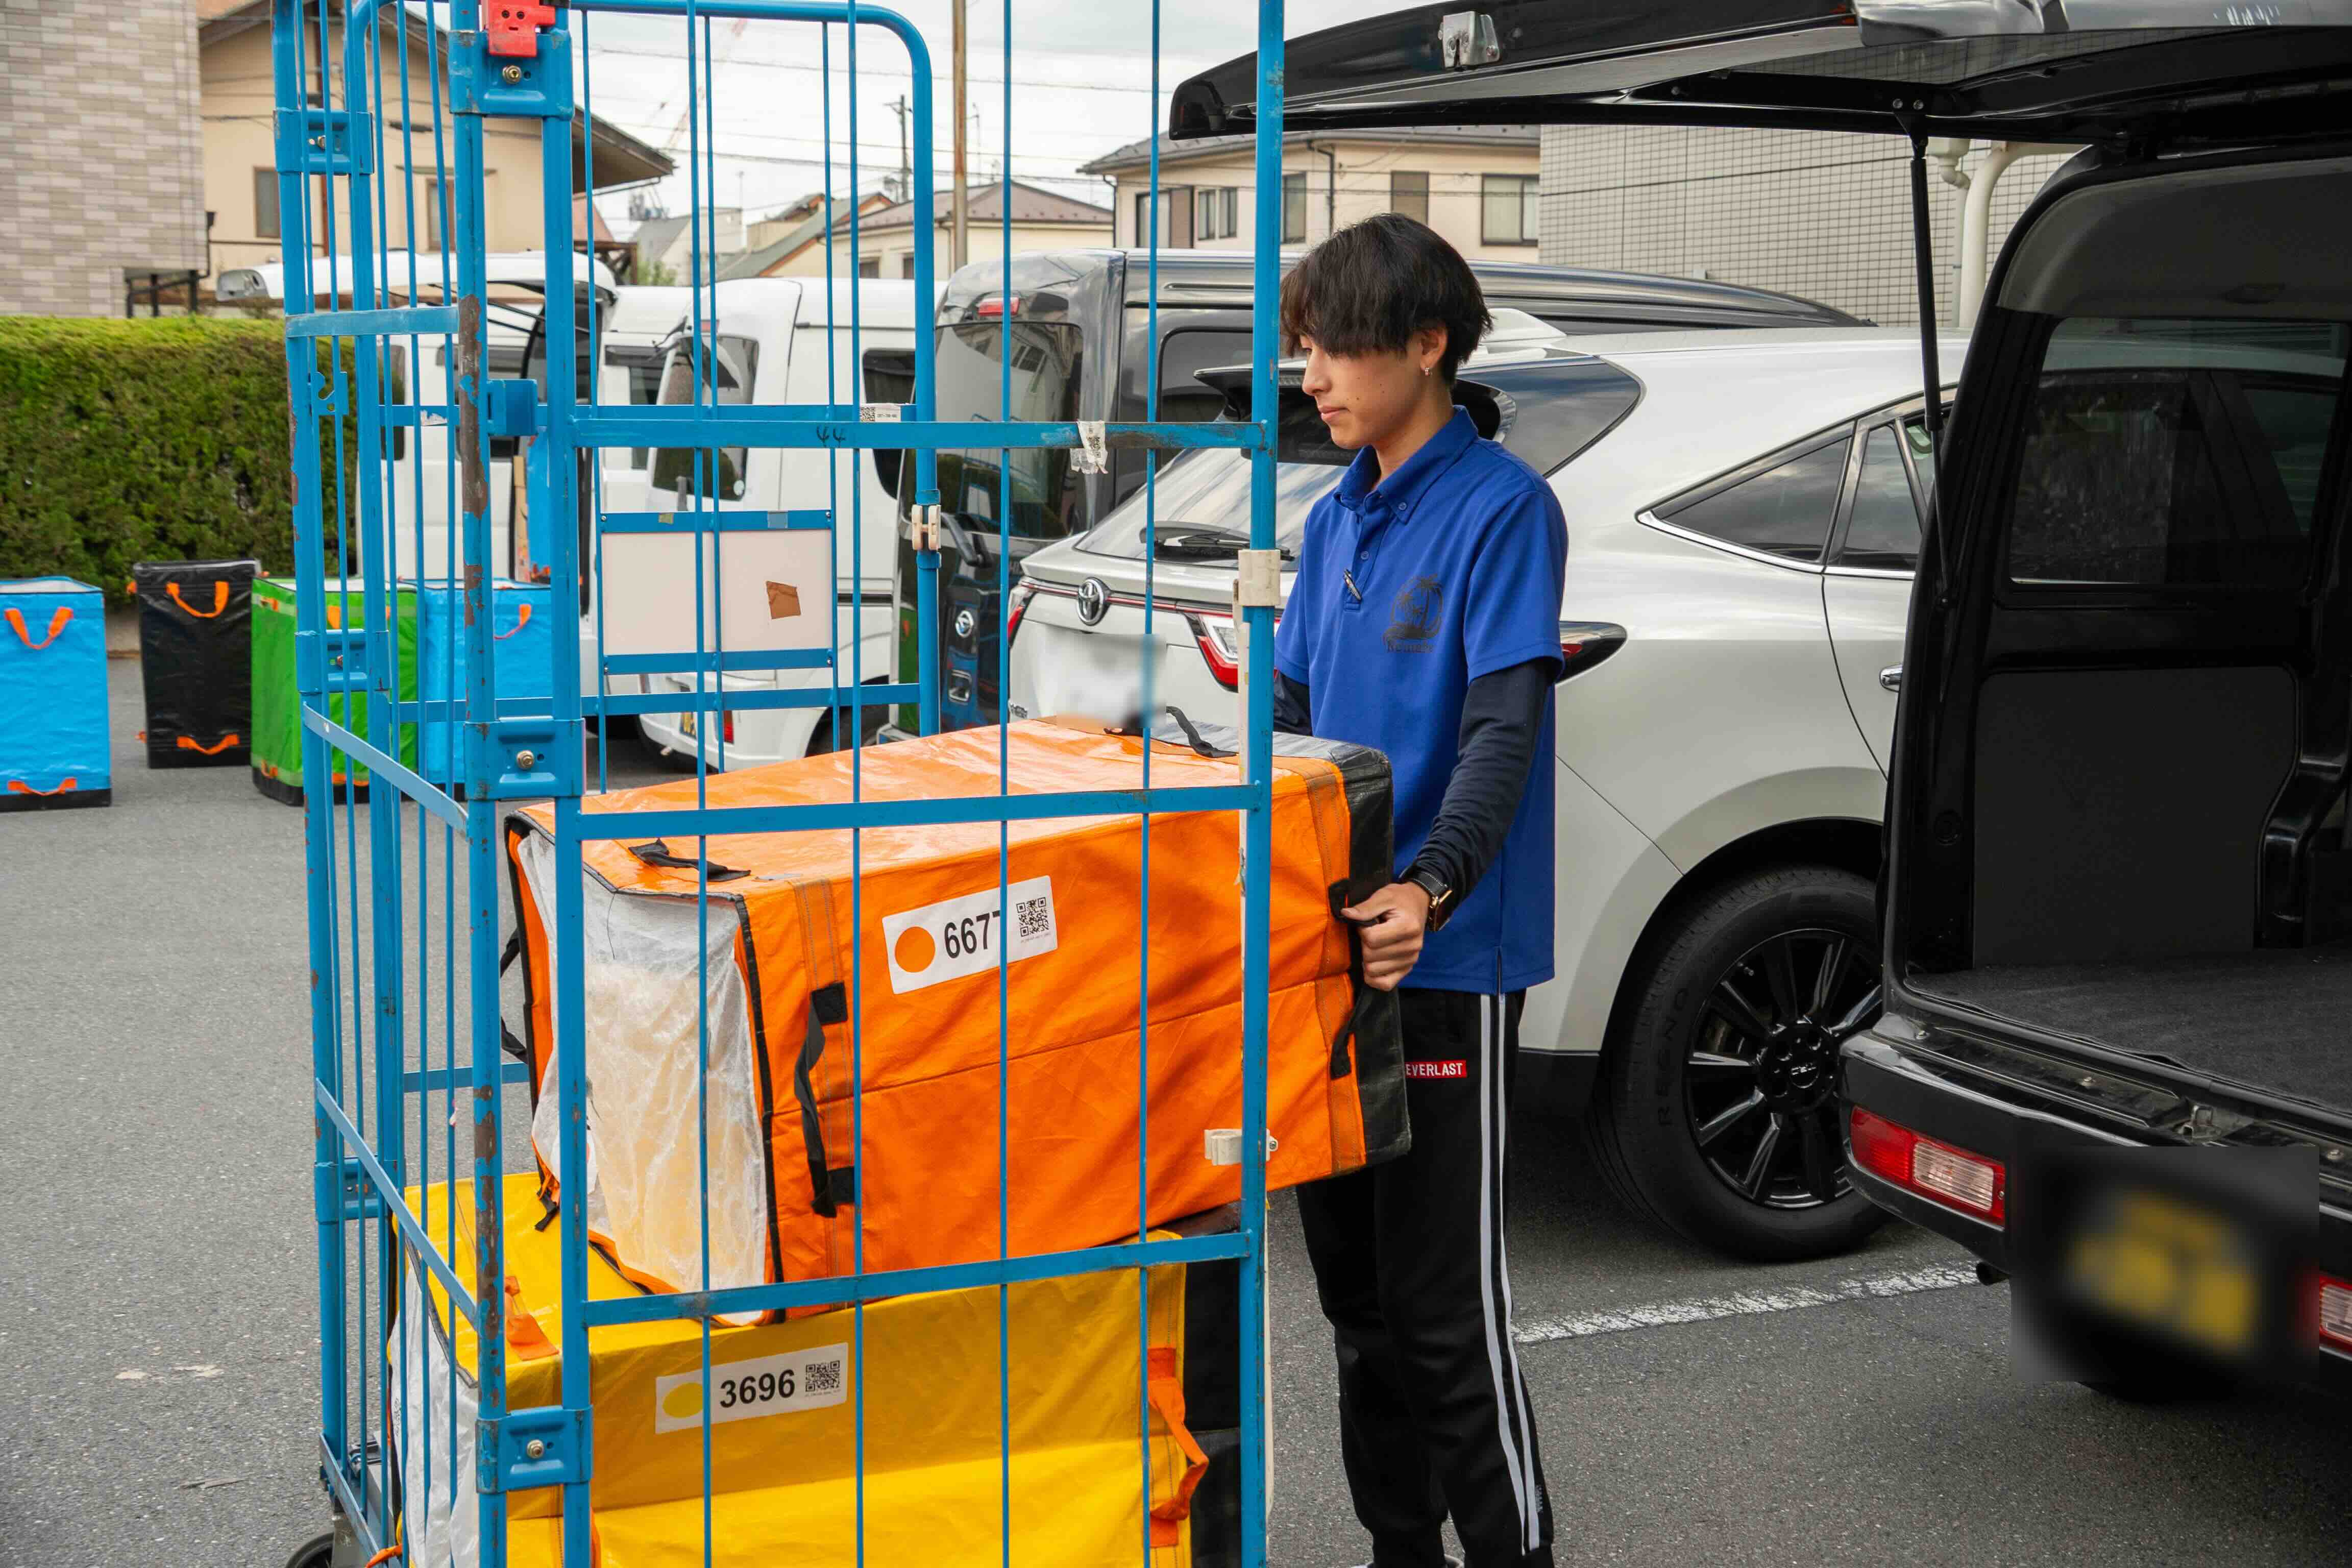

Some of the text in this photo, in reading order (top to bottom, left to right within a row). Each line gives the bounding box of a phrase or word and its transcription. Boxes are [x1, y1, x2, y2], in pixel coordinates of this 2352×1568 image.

[944, 910, 1000, 959] 667
[1405, 1063, 1463, 1076] EVERLAST
[720, 1369, 795, 1408] 3696
